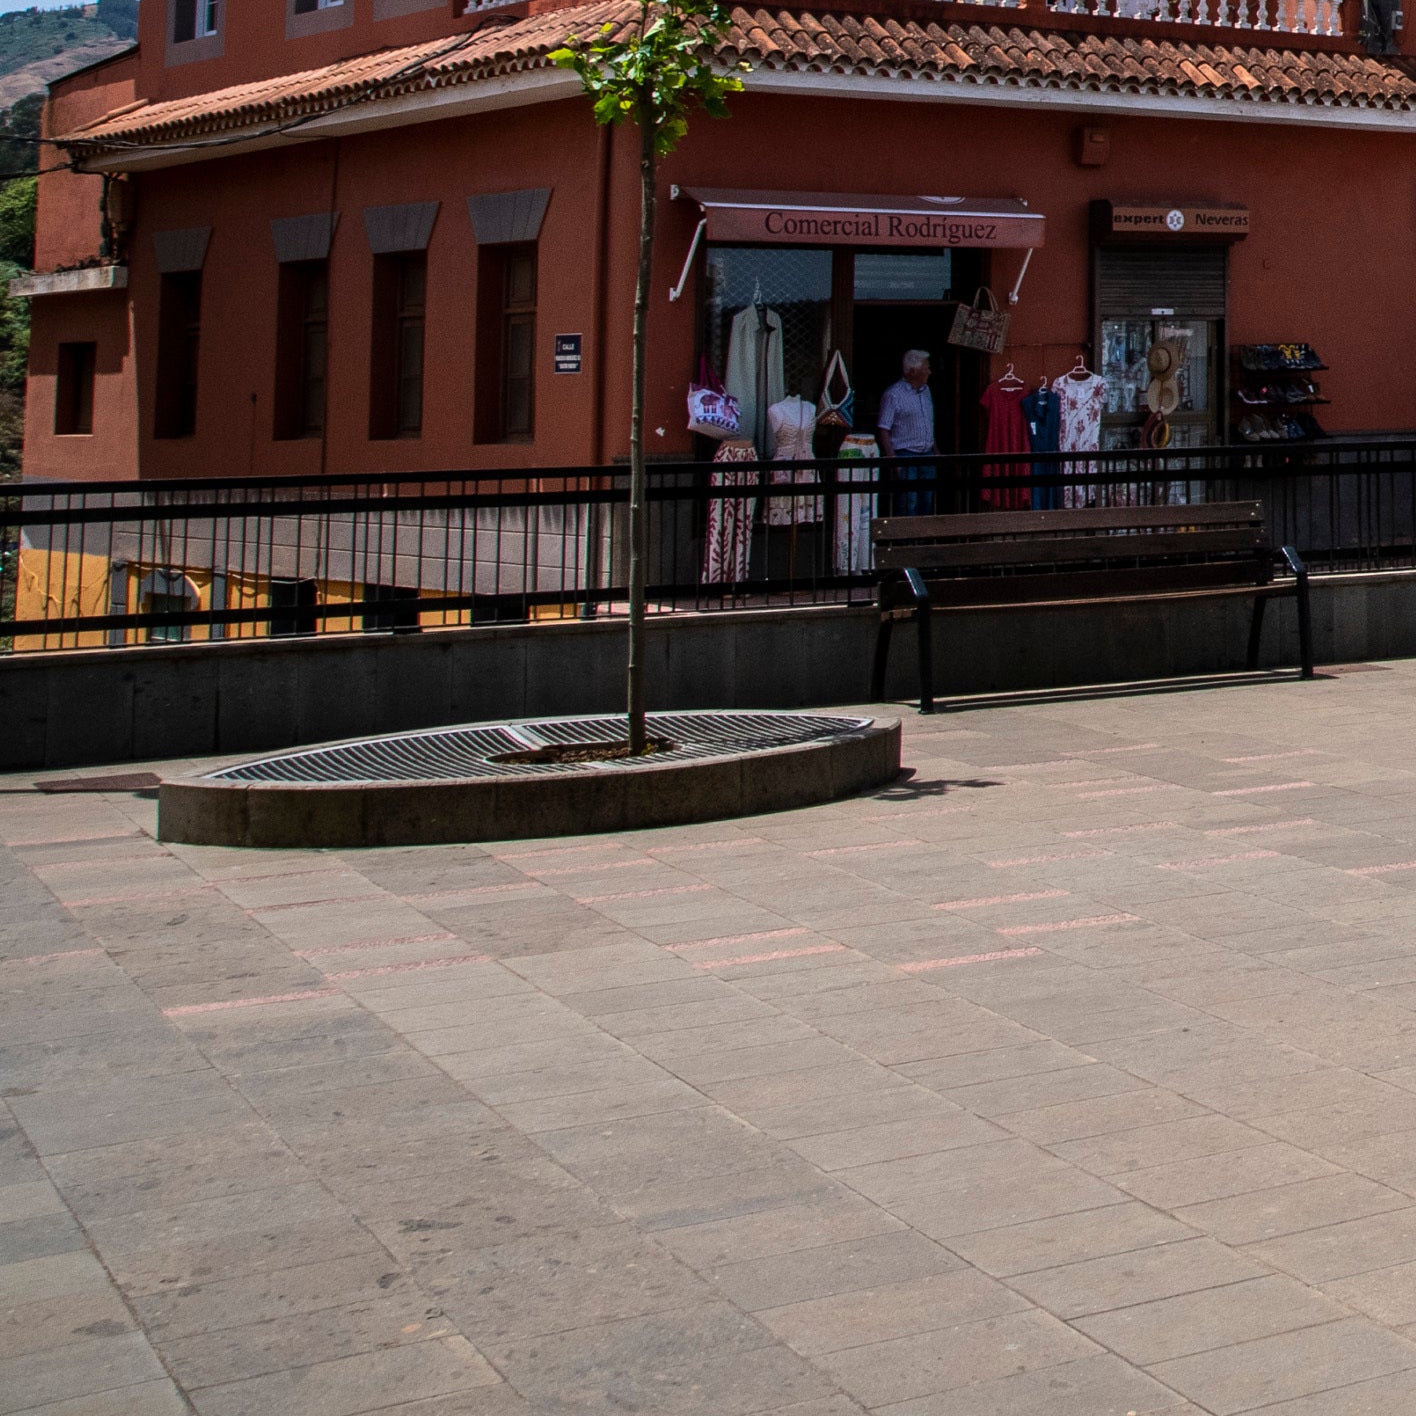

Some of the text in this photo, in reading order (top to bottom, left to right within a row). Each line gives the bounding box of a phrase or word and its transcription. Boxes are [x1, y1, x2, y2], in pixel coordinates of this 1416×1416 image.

[764, 211, 997, 244] Comercial Rodríguez
[1113, 213, 1248, 226] expert Neveras
